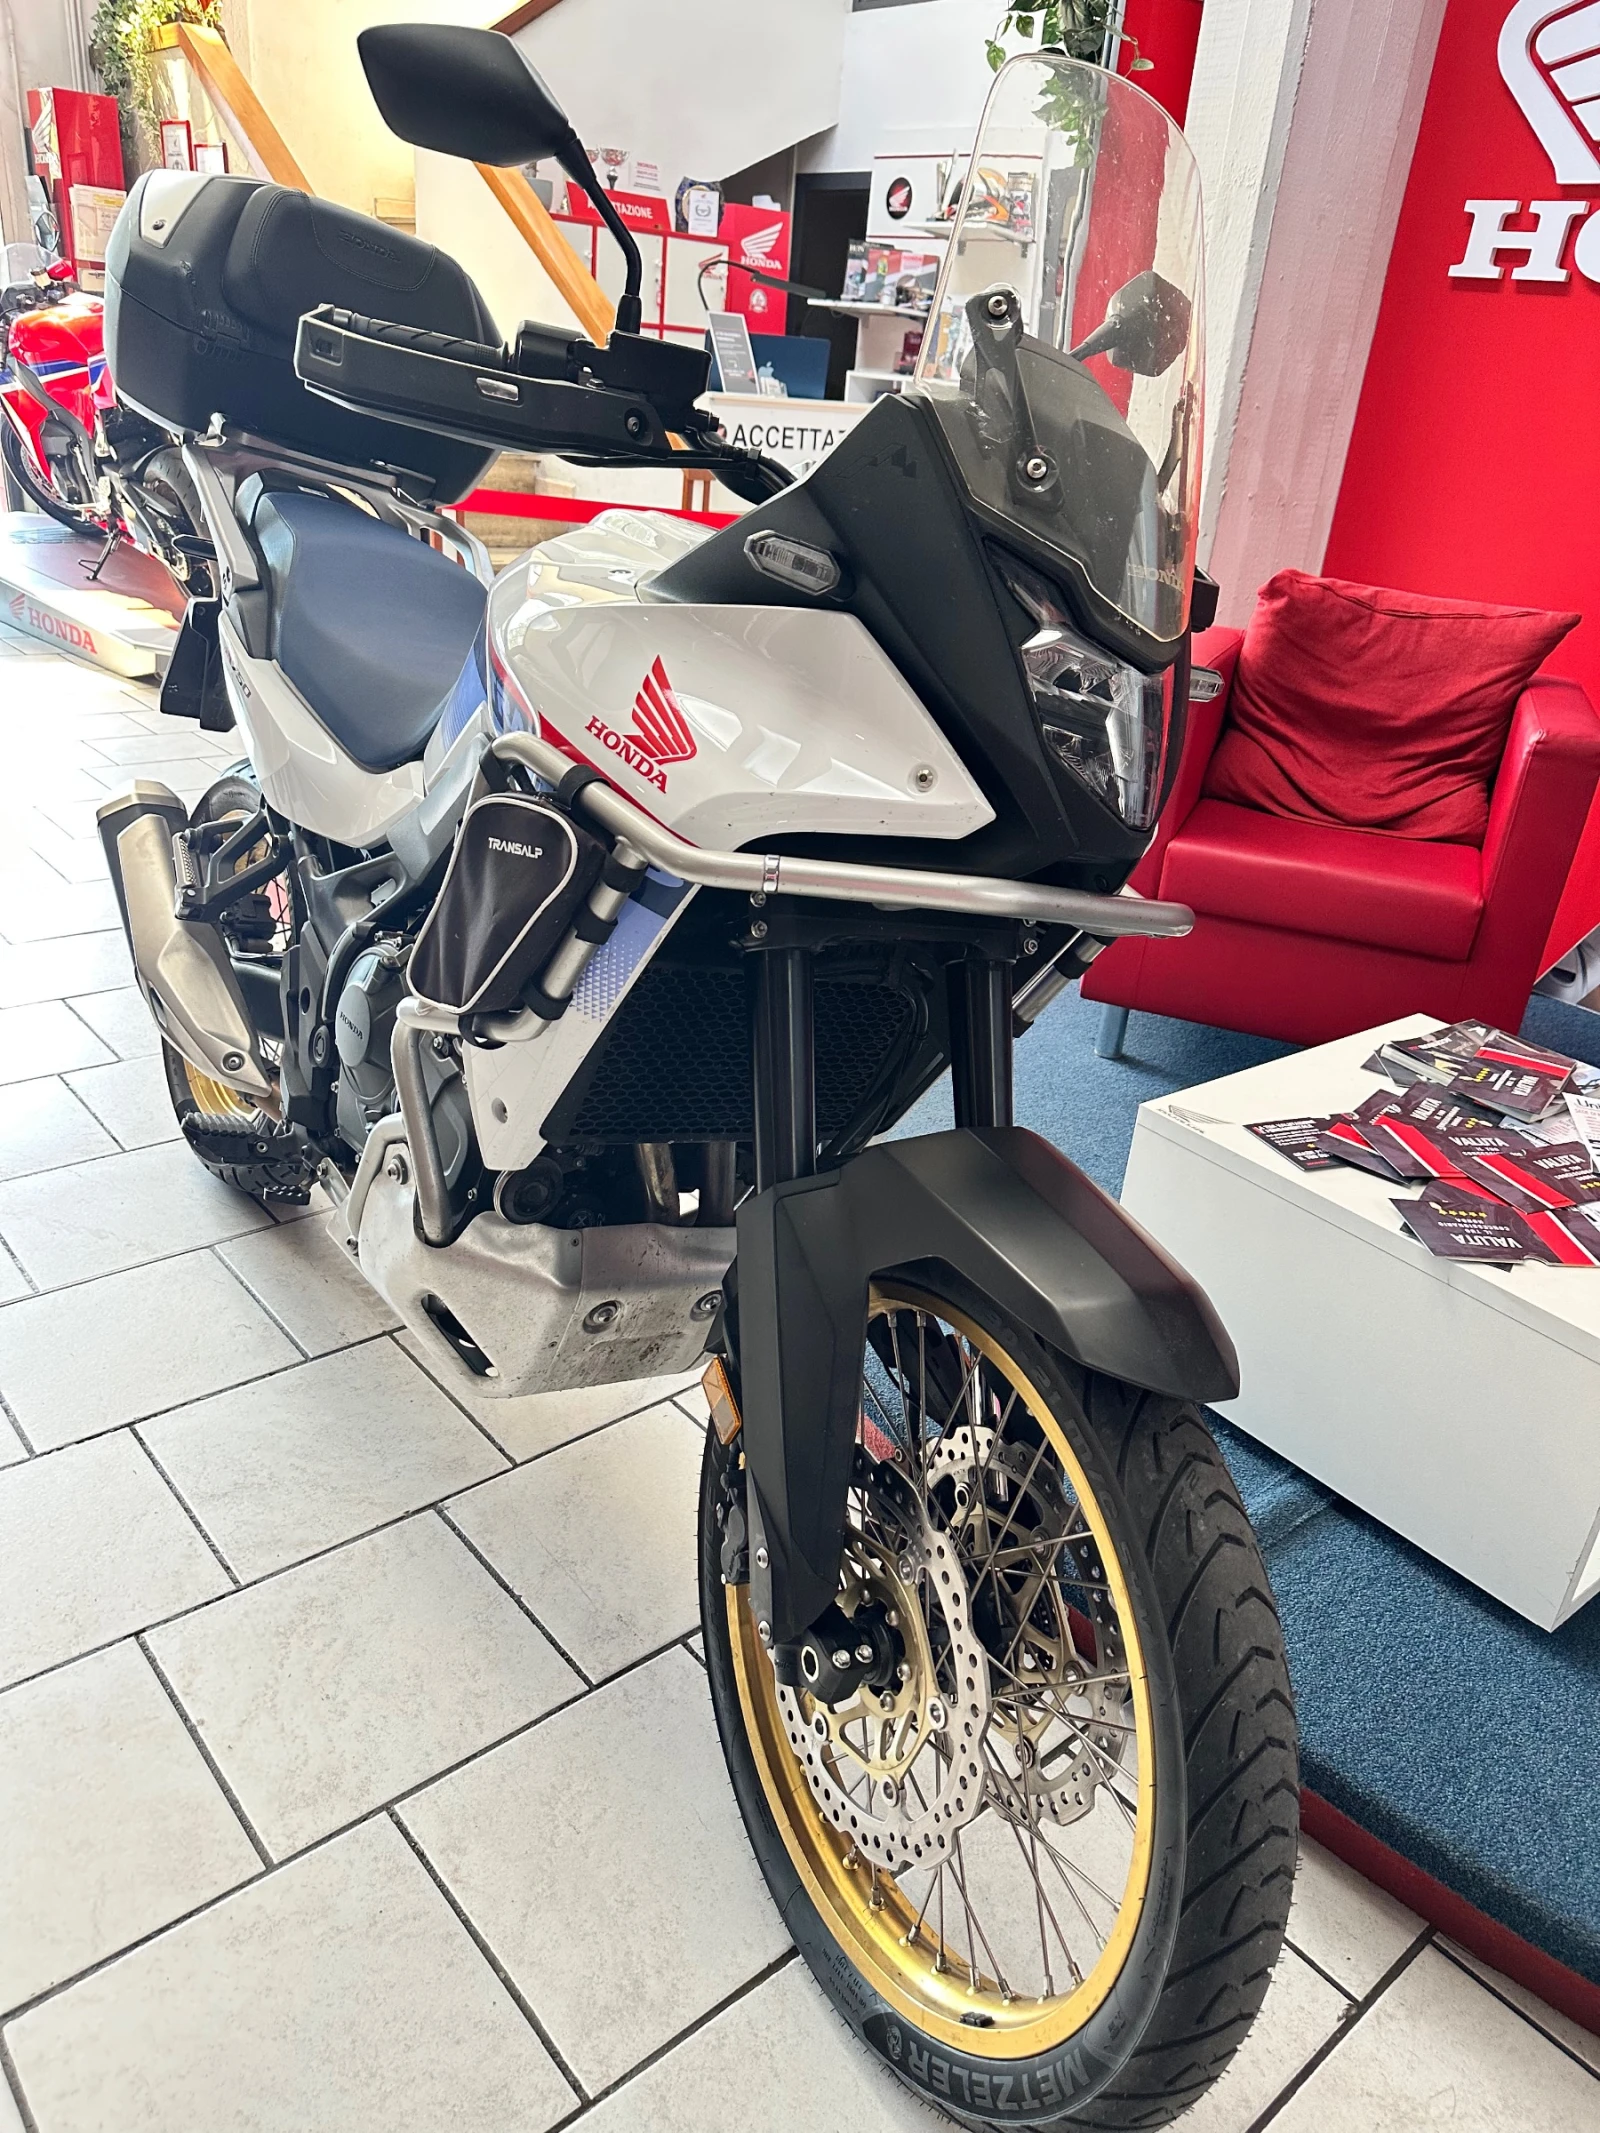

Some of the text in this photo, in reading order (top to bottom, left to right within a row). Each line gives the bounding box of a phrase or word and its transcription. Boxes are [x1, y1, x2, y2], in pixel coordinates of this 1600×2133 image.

[741, 256, 783, 270] HONDA
[732, 424, 846, 452] ACCETTA
[27, 606, 98, 655] HONDA
[584, 715, 667, 794] HONDA
[488, 836, 543, 859] TRANSALP
[340, 1011, 363, 1040] HONDA
[1449, 1136, 1510, 1148] VALUTA
[1533, 1154, 1586, 1170] VALUTA
[1450, 1233, 1523, 1249] VALUTA
[908, 2040, 1091, 2112] METZELER
